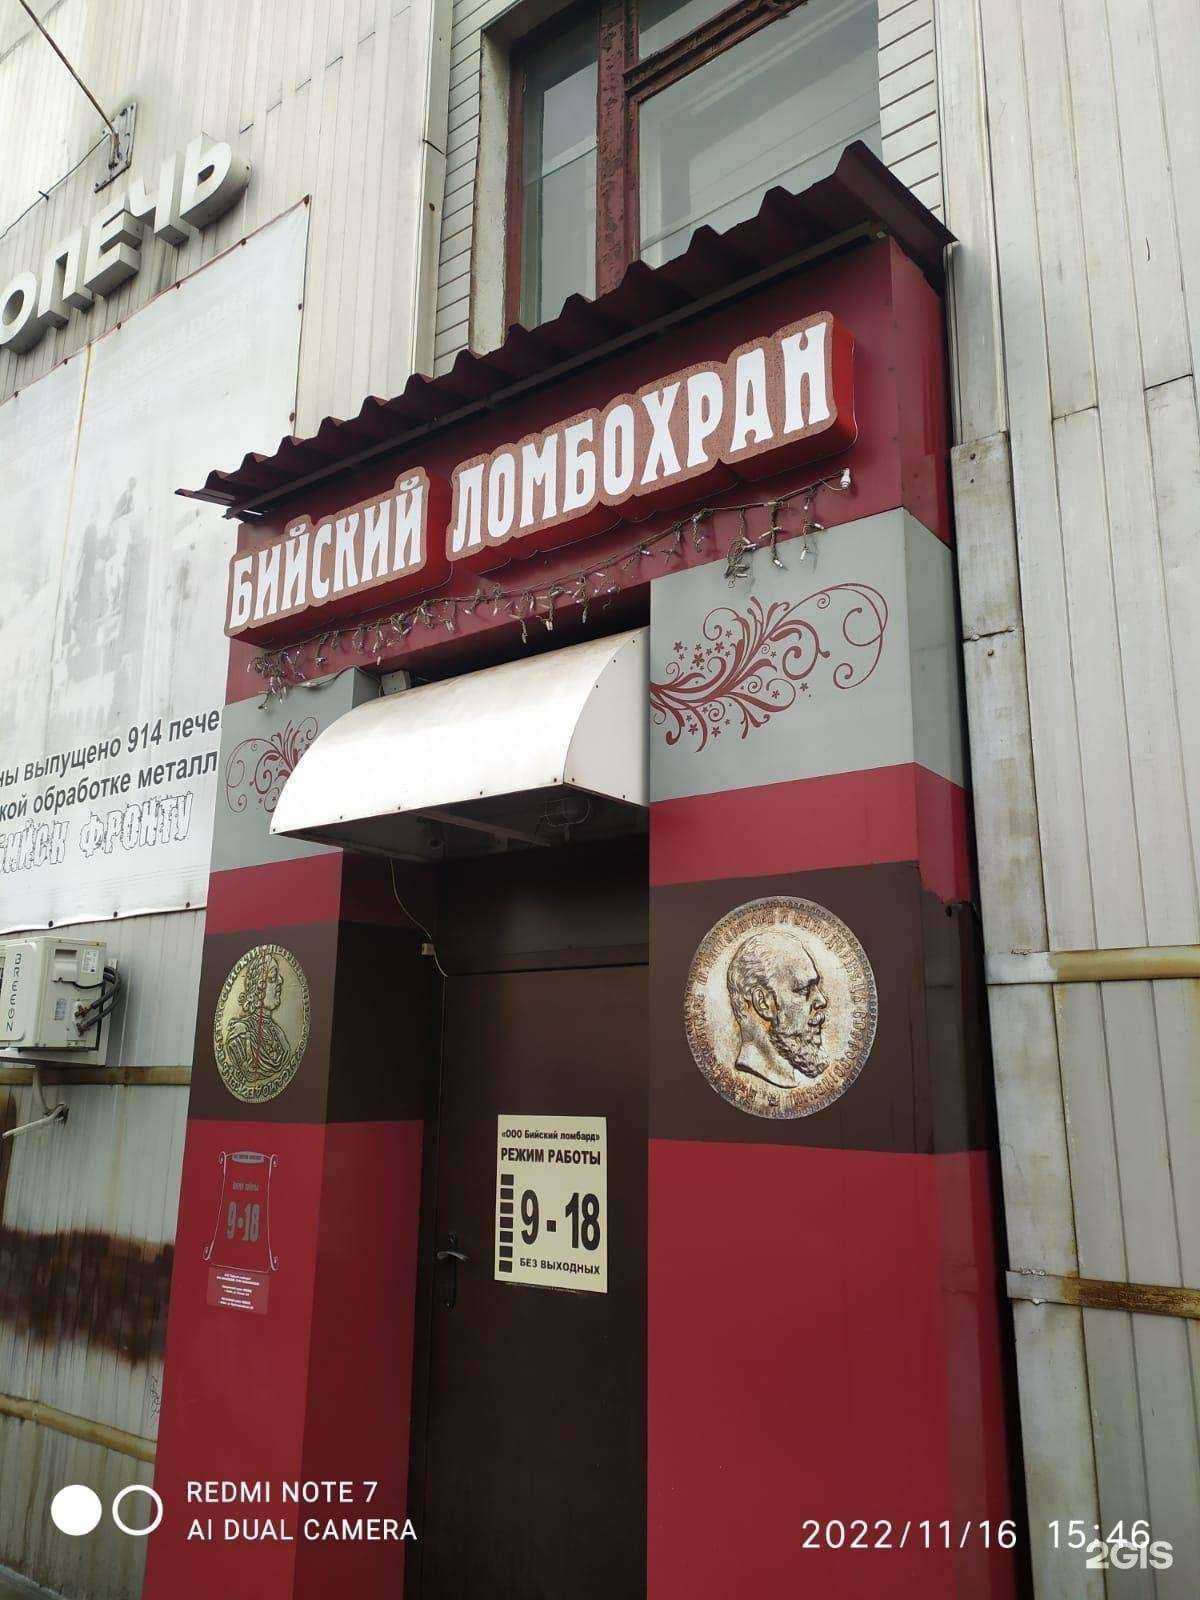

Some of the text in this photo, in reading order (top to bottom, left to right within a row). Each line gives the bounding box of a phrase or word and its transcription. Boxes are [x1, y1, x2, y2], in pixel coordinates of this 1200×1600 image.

[229, 321, 831, 629] БИЙСКИЙ ЛОМБОХРАН
[24, 737, 121, 782] выпущено
[128, 719, 162, 753] 914
[169, 709, 220, 742] пече
[33, 772, 131, 816] обработке
[138, 751, 218, 789] металл
[524, 1129, 558, 1140] Бийский
[501, 1147, 601, 1165] РЕЖИМ РАБОТЫ
[519, 1257, 601, 1275] БЕЗ ВЫХОДНЫХ
